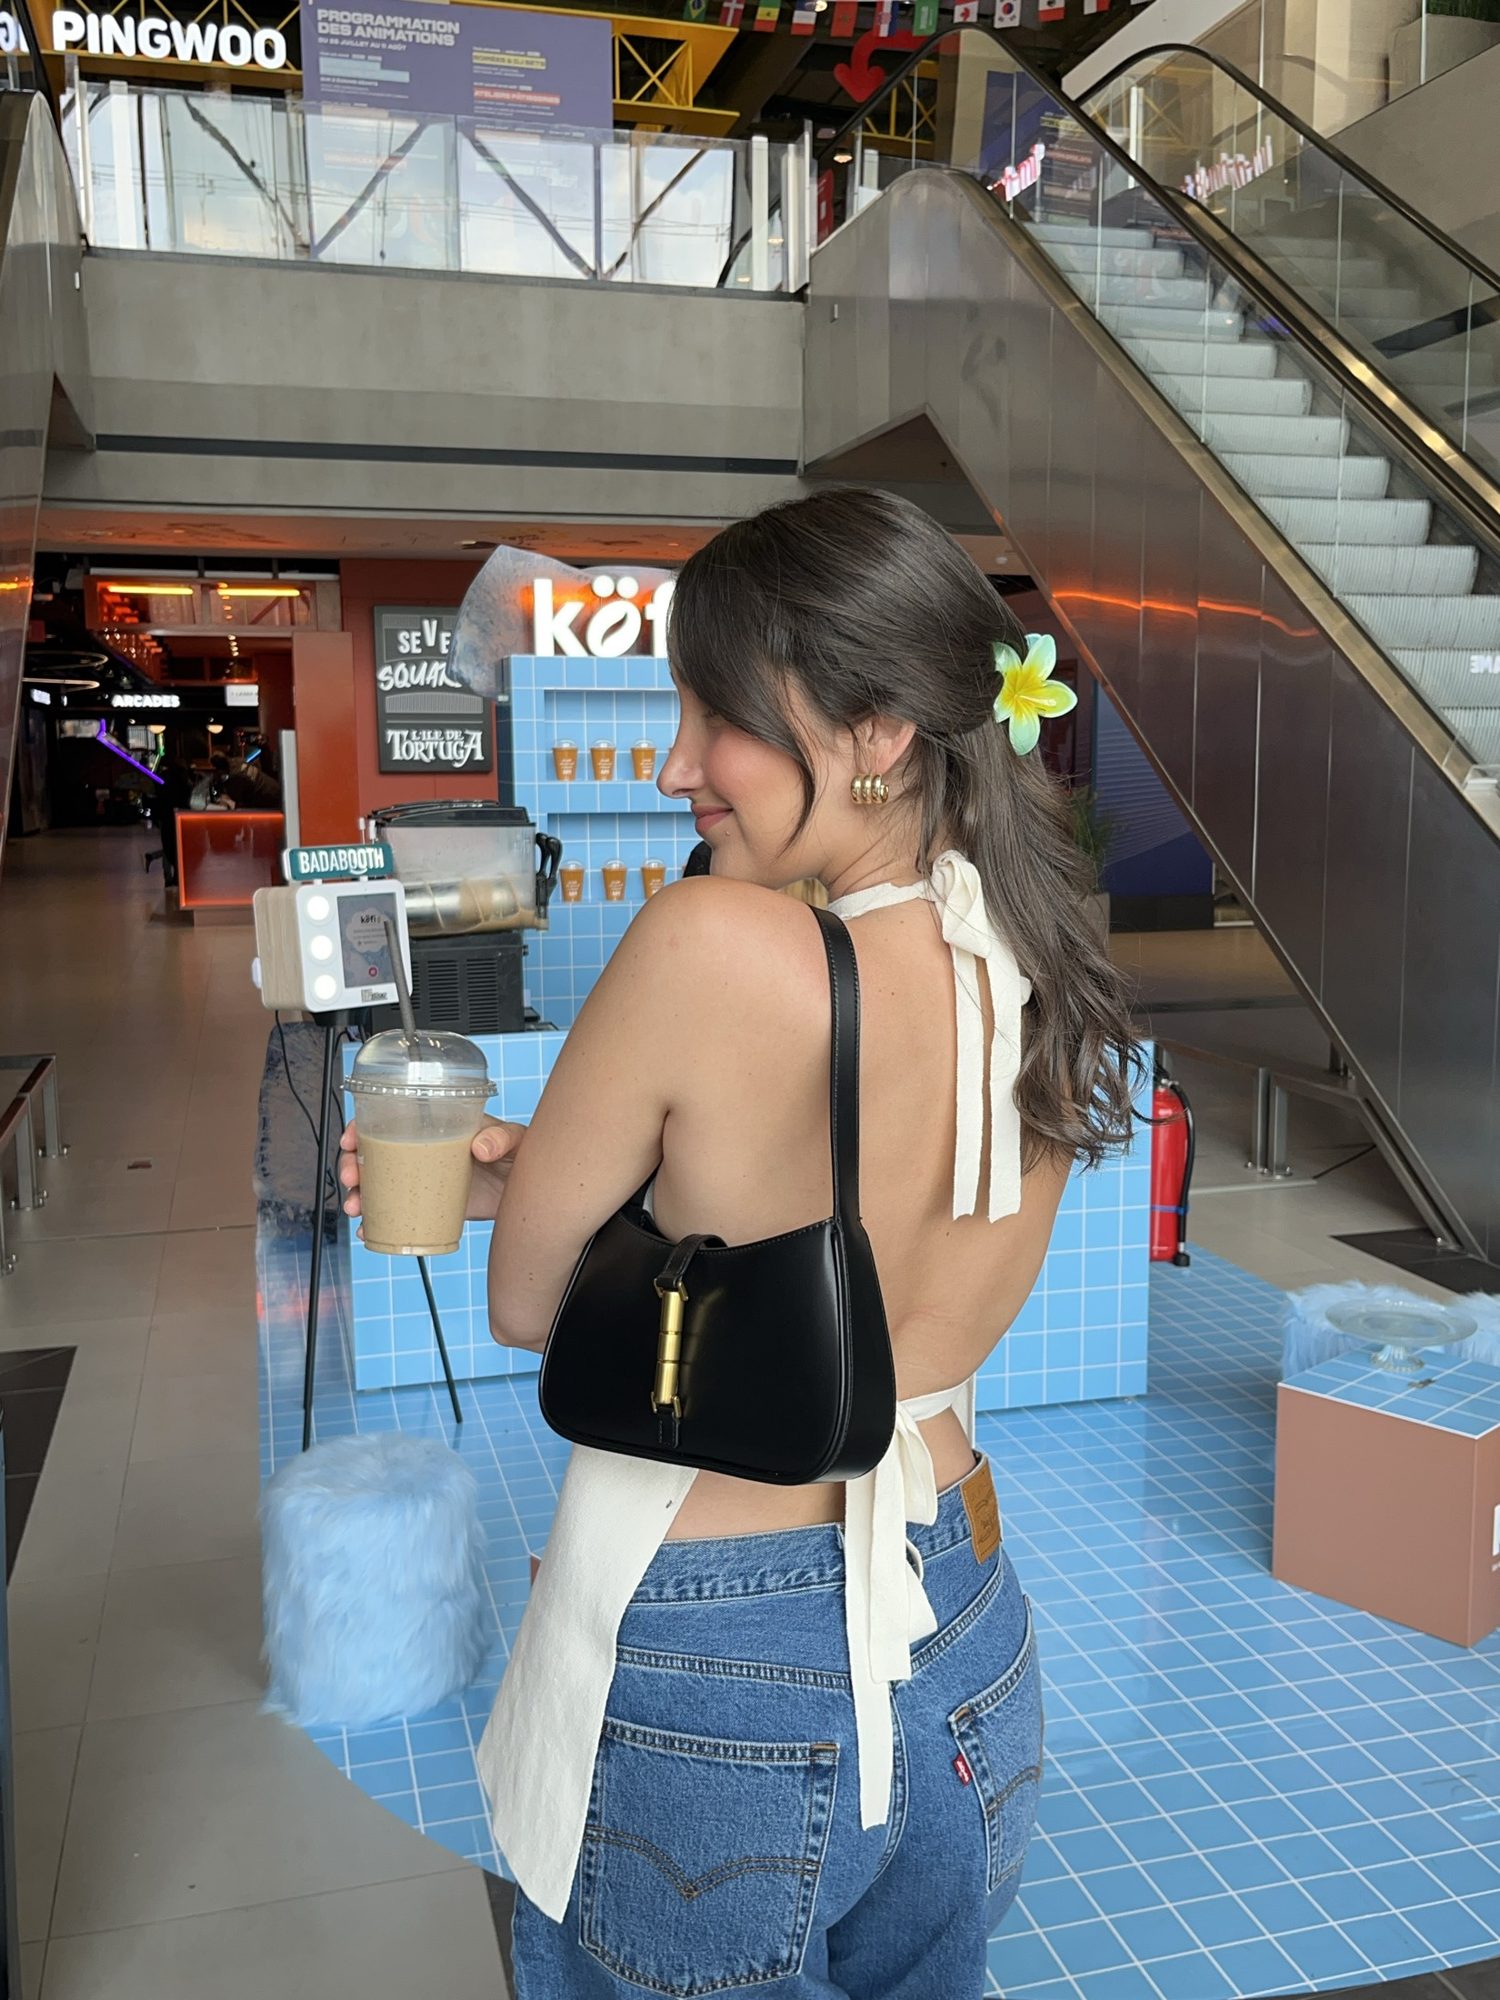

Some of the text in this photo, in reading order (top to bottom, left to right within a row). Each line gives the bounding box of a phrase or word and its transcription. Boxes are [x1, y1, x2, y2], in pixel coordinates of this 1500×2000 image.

[317, 8, 460, 34] PROGRAMMATION
[318, 22, 455, 47] DES ANIMATIONS
[52, 10, 287, 70] PINGWOO
[533, 575, 676, 658] köf
[112, 694, 181, 708] ARCADES
[386, 728, 485, 768] TORTUGA
[445, 729, 465, 741] DE
[299, 847, 385, 875] BADABOOTH
